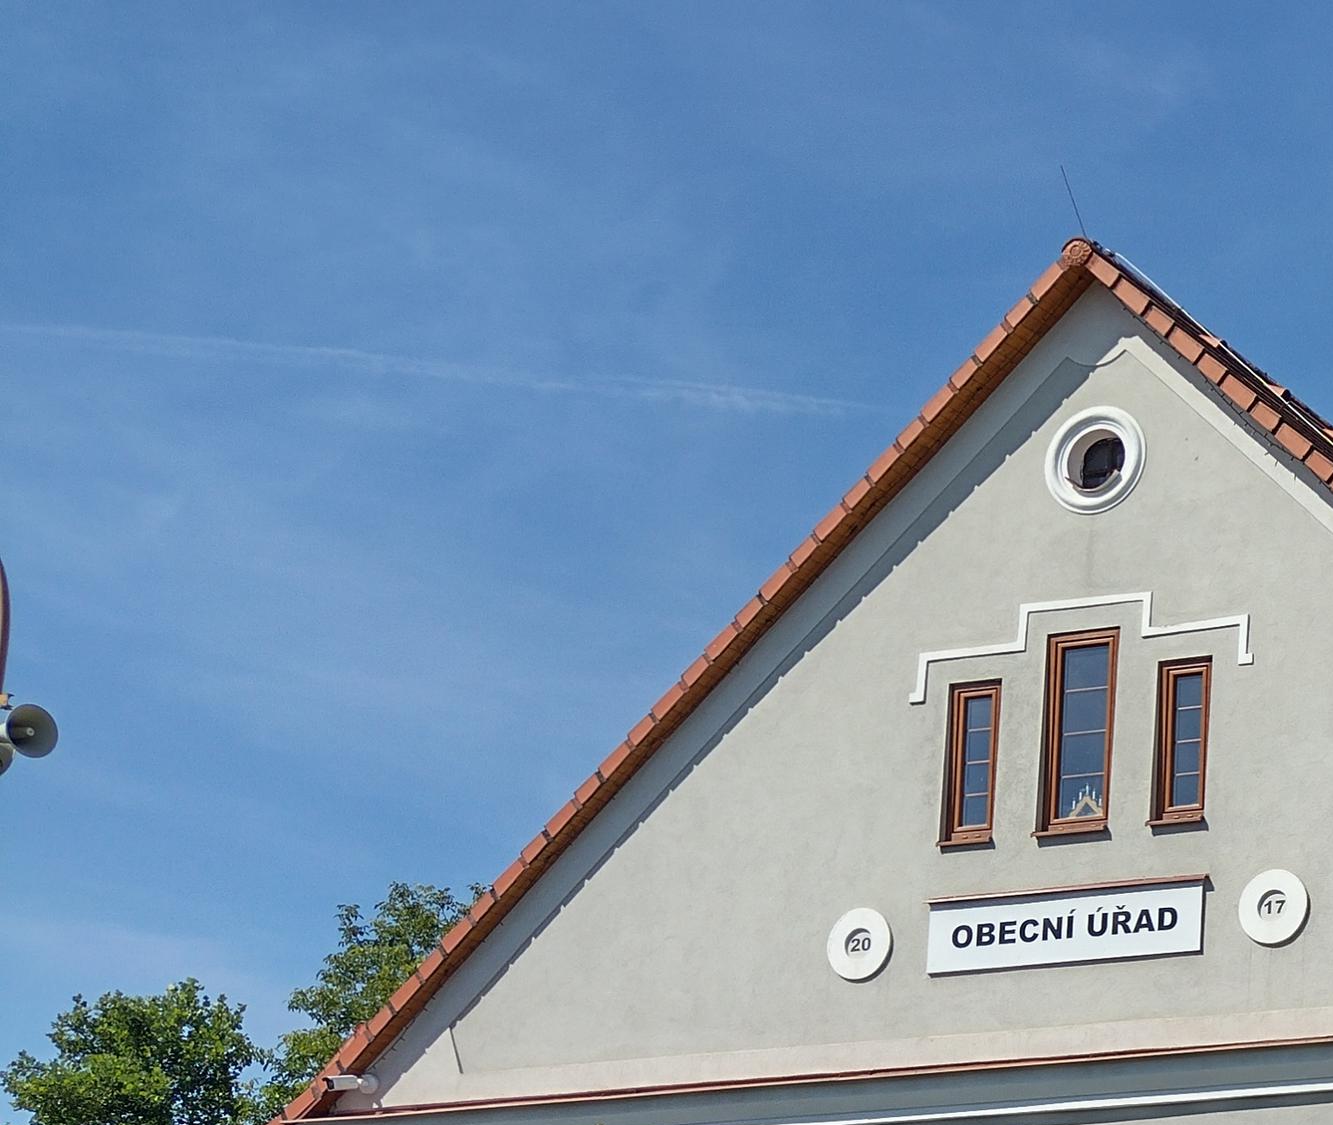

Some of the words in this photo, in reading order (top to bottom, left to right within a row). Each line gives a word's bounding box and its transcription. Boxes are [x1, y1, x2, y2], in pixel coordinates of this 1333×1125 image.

[1264, 900, 1286, 914] 17
[951, 909, 1076, 949] OBECNÍ
[1087, 904, 1178, 937] ÚŘAD
[850, 937, 871, 953] 20
